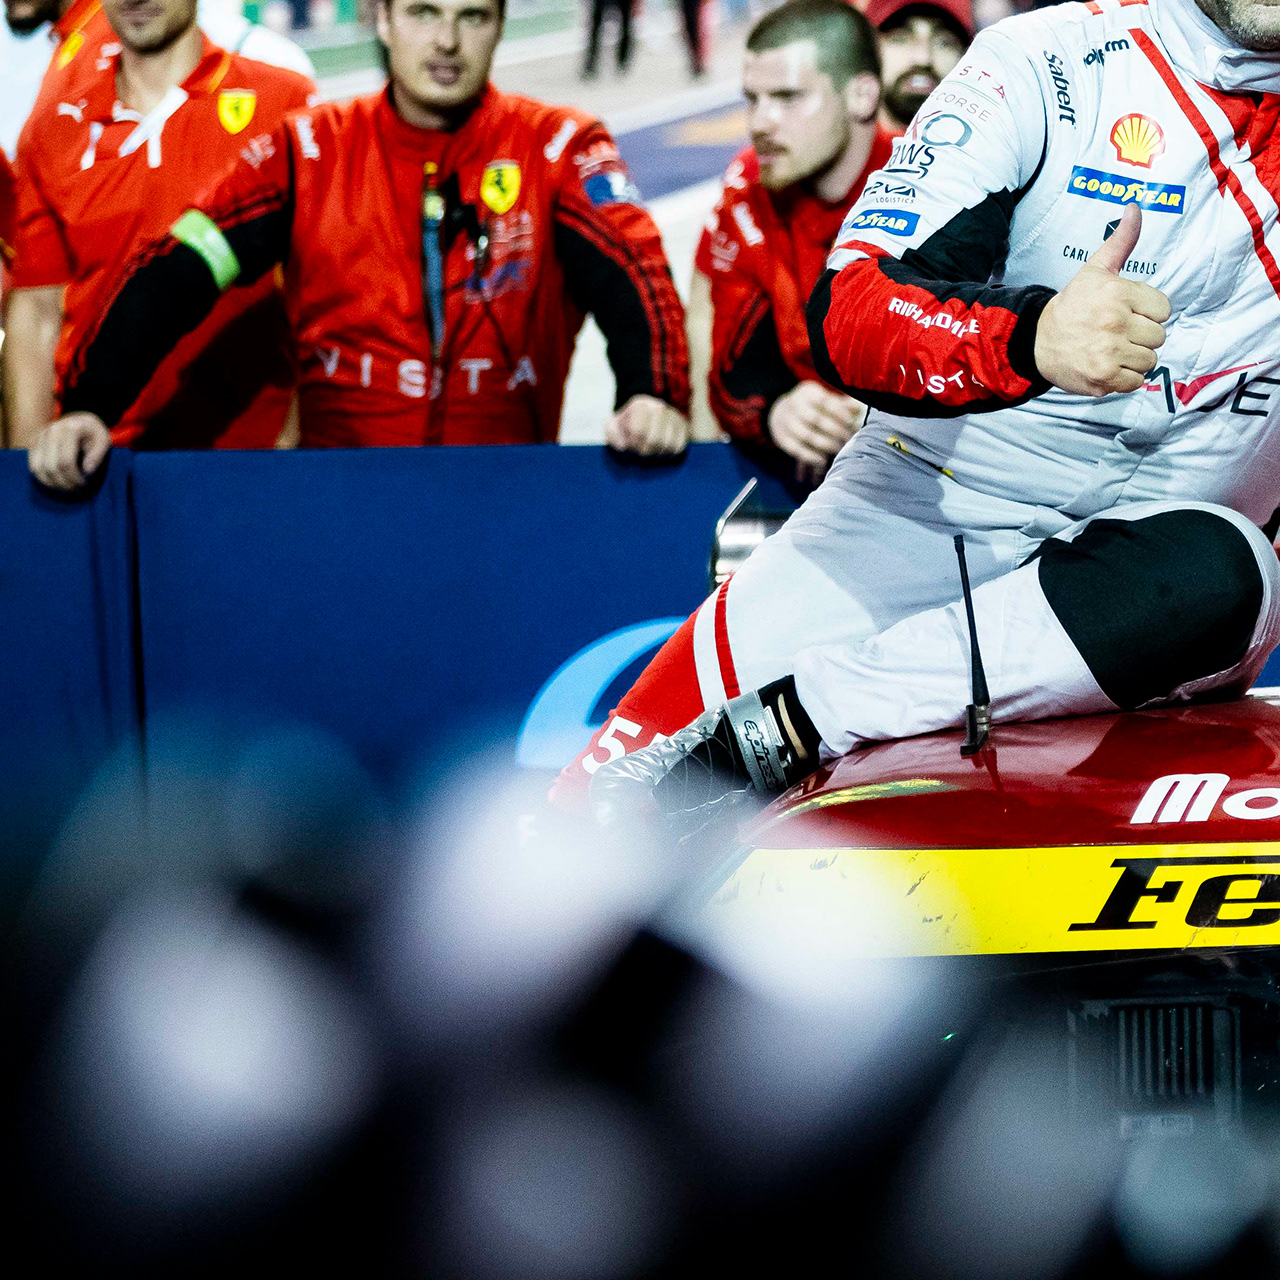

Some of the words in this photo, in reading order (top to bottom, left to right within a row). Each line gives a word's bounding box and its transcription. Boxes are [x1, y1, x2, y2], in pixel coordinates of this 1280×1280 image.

[959, 65, 1006, 99] STA
[1043, 49, 1078, 131] Sabelt
[1073, 176, 1182, 207] GOODYEAR
[315, 346, 538, 400] VISTA
